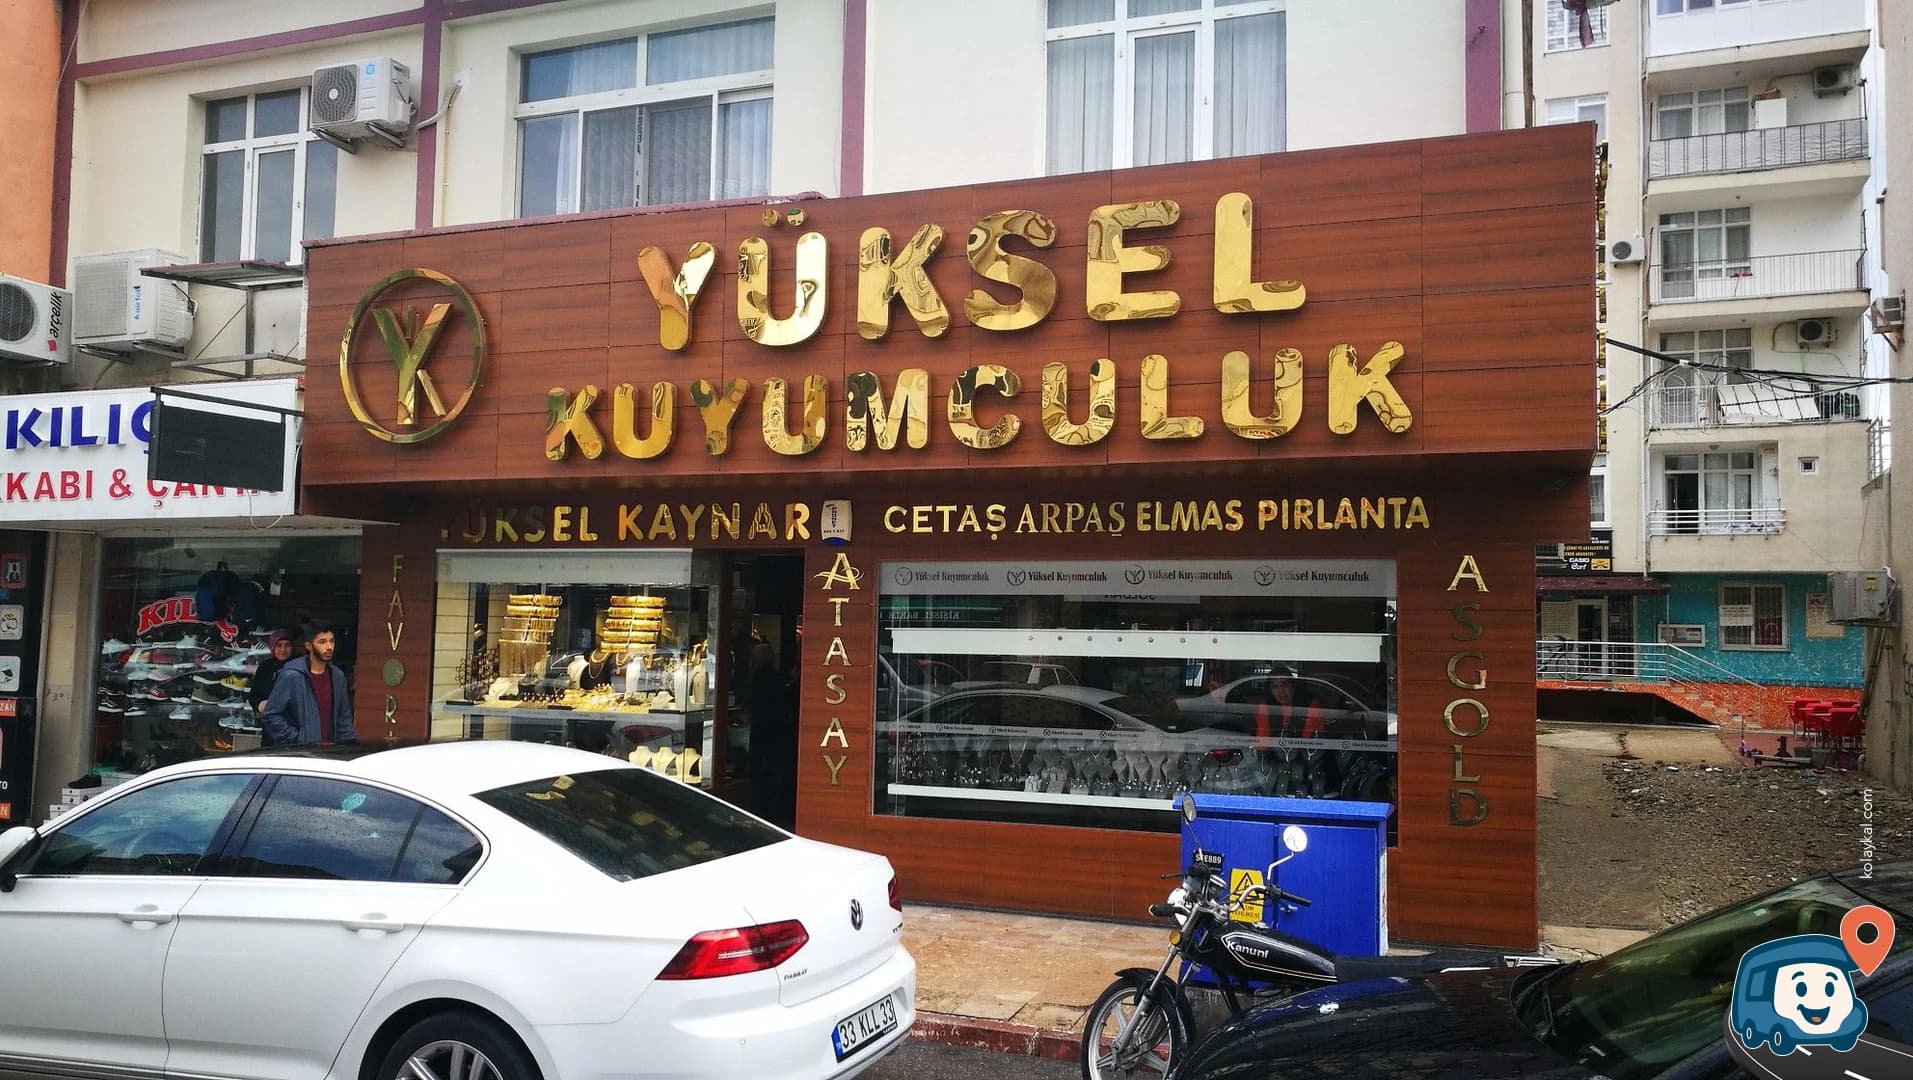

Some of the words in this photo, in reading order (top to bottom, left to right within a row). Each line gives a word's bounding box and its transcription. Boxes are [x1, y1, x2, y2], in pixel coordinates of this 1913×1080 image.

[637, 192, 1307, 352] YÜKSEL
[50, 291, 63, 338] arçelik
[545, 341, 1414, 462] KUYUMCULUK
[0, 469, 94, 500] KABI
[109, 468, 132, 498] &
[439, 499, 599, 543] ÜKSEL
[619, 502, 811, 541] KAYNAR
[884, 503, 1007, 541] CETAŞ
[1015, 501, 1126, 538] ARPAŞ
[1136, 499, 1244, 532] ELMAS
[1257, 496, 1430, 530] PIRLANTA
[1028, 571, 1055, 582] Yüksel
[1178, 569, 1233, 583] Kuyumculuk
[1311, 570, 1370, 584] Kuyumculuk
[814, 552, 865, 785] ATASAY
[1442, 554, 1490, 827] ASGOLD
[839, 1021, 857, 1049] 33
[858, 1011, 881, 1039] KLL
[880, 1000, 895, 1025] 33
